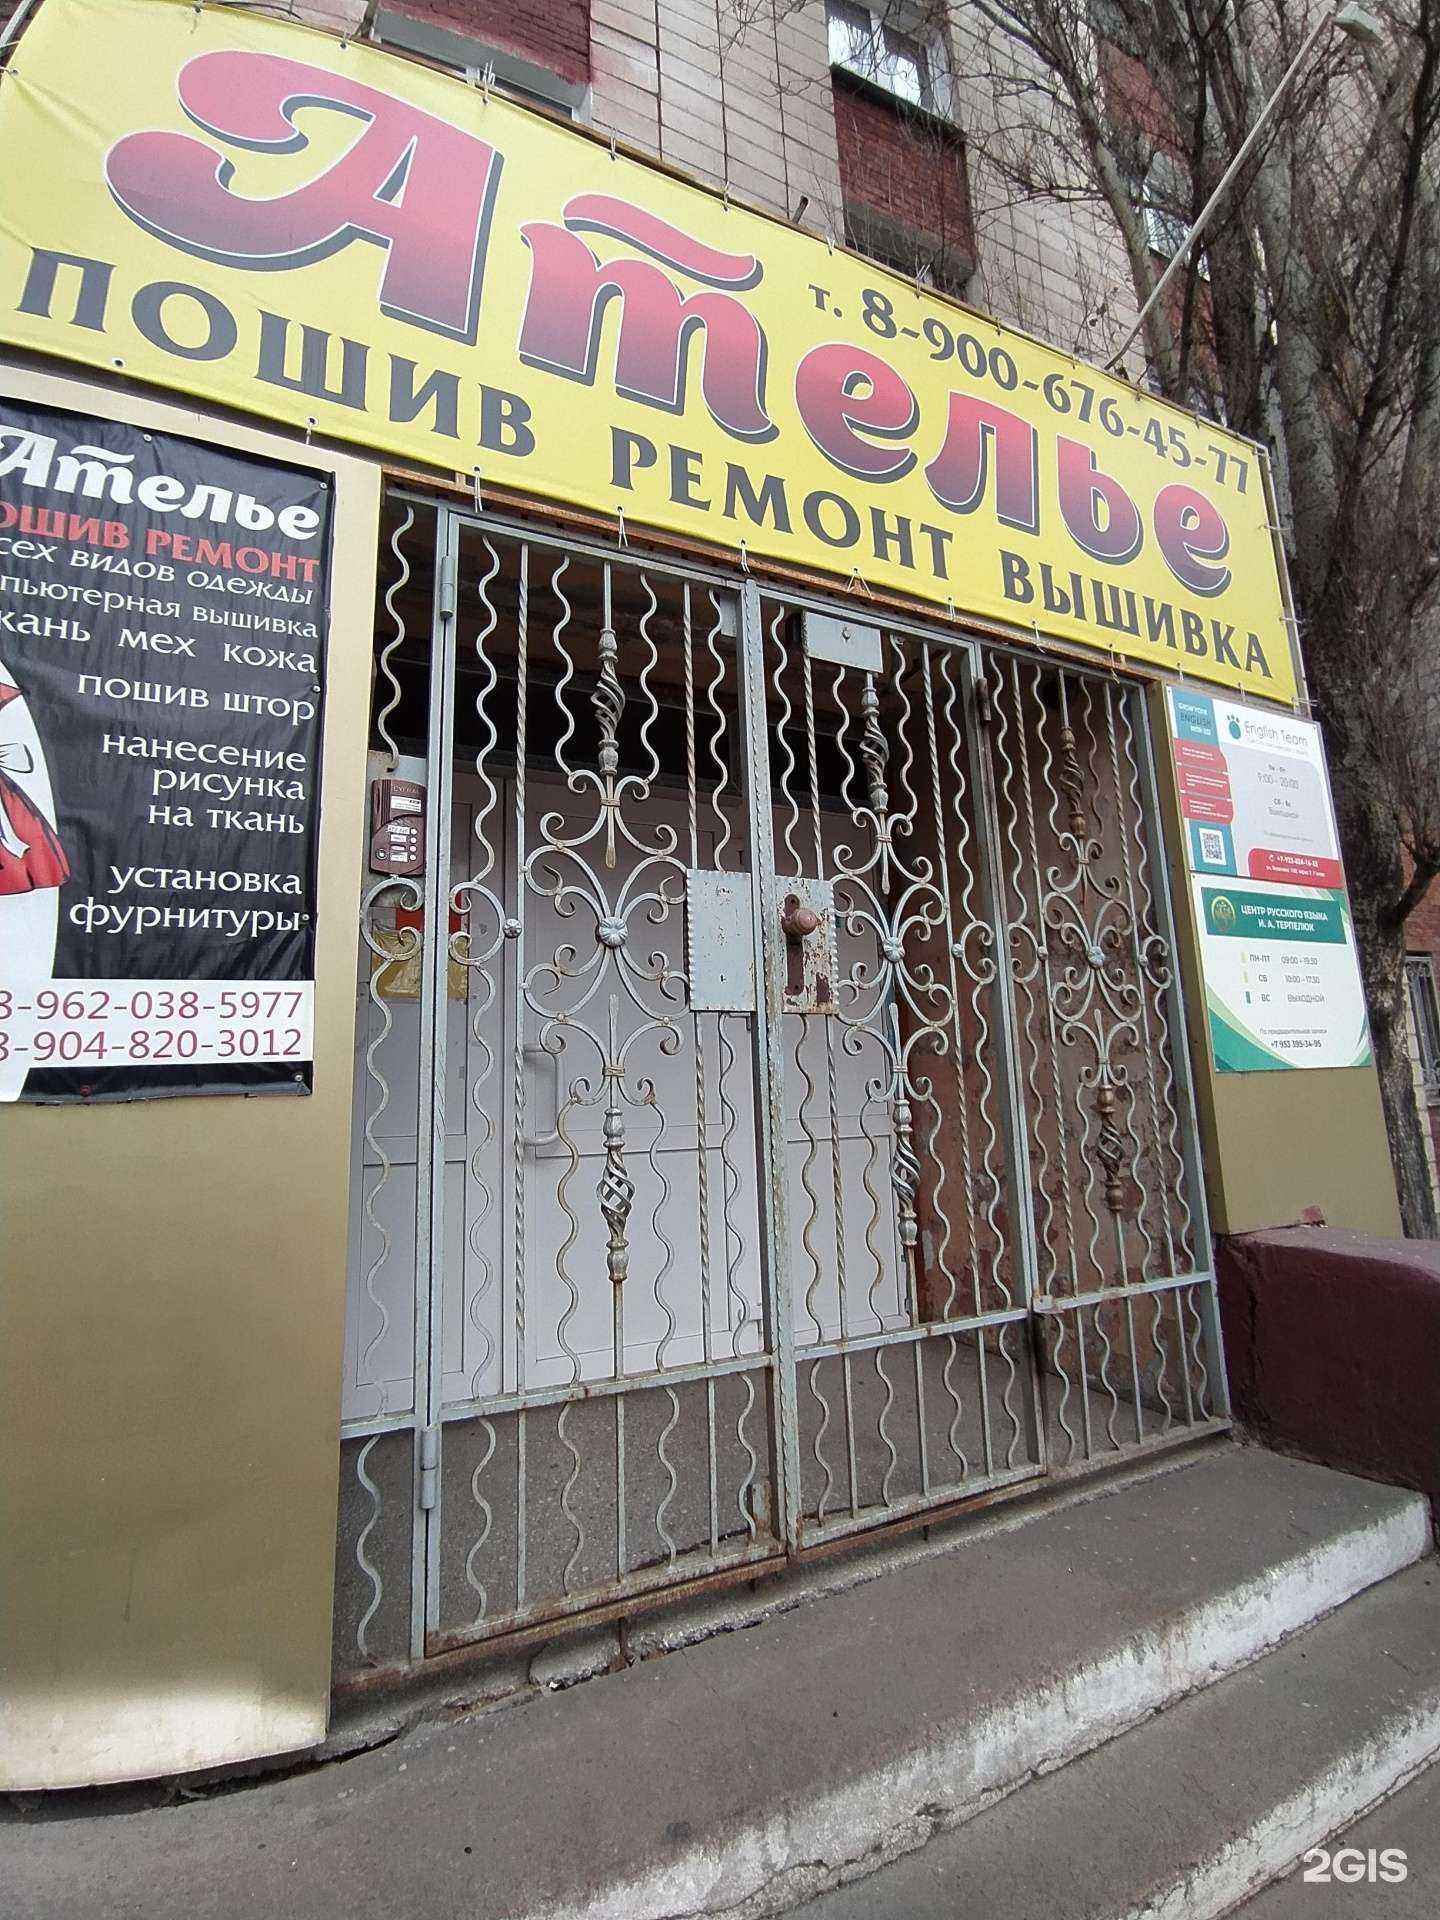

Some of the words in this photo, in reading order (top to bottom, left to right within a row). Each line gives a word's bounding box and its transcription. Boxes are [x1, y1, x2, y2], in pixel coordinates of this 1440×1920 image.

[104, 49, 1233, 598] Ателье
[808, 283, 843, 318] т.
[861, 288, 1249, 494] 8-900-676-45-77
[16, 247, 537, 457] ПОШИВ
[611, 426, 953, 581] РЕМОНТ
[999, 549, 1272, 679] ВЫШИВКА
[70, 549, 175, 582] видов
[187, 570, 313, 605] одежды
[146, 528, 320, 583] РЕМОНТ
[0, 574, 181, 619] пьютерная
[192, 605, 318, 638] вышивка
[118, 628, 197, 657] мех
[223, 642, 318, 674] кожа
[77, 673, 210, 708] пошив
[223, 691, 315, 726] штор
[102, 733, 307, 772] нанесение
[1244, 720, 1278, 740] English
[151, 768, 306, 801] рисунка
[148, 804, 194, 828] на
[207, 808, 305, 834] ткань
[107, 864, 303, 895] установка
[69, 896, 299, 937] фурнитуры
[1241, 904, 1265, 915] ЦЕНТР
[1267, 907, 1303, 919] РУССКОГО
[1304, 910, 1328, 921] ЯЗЫКА
